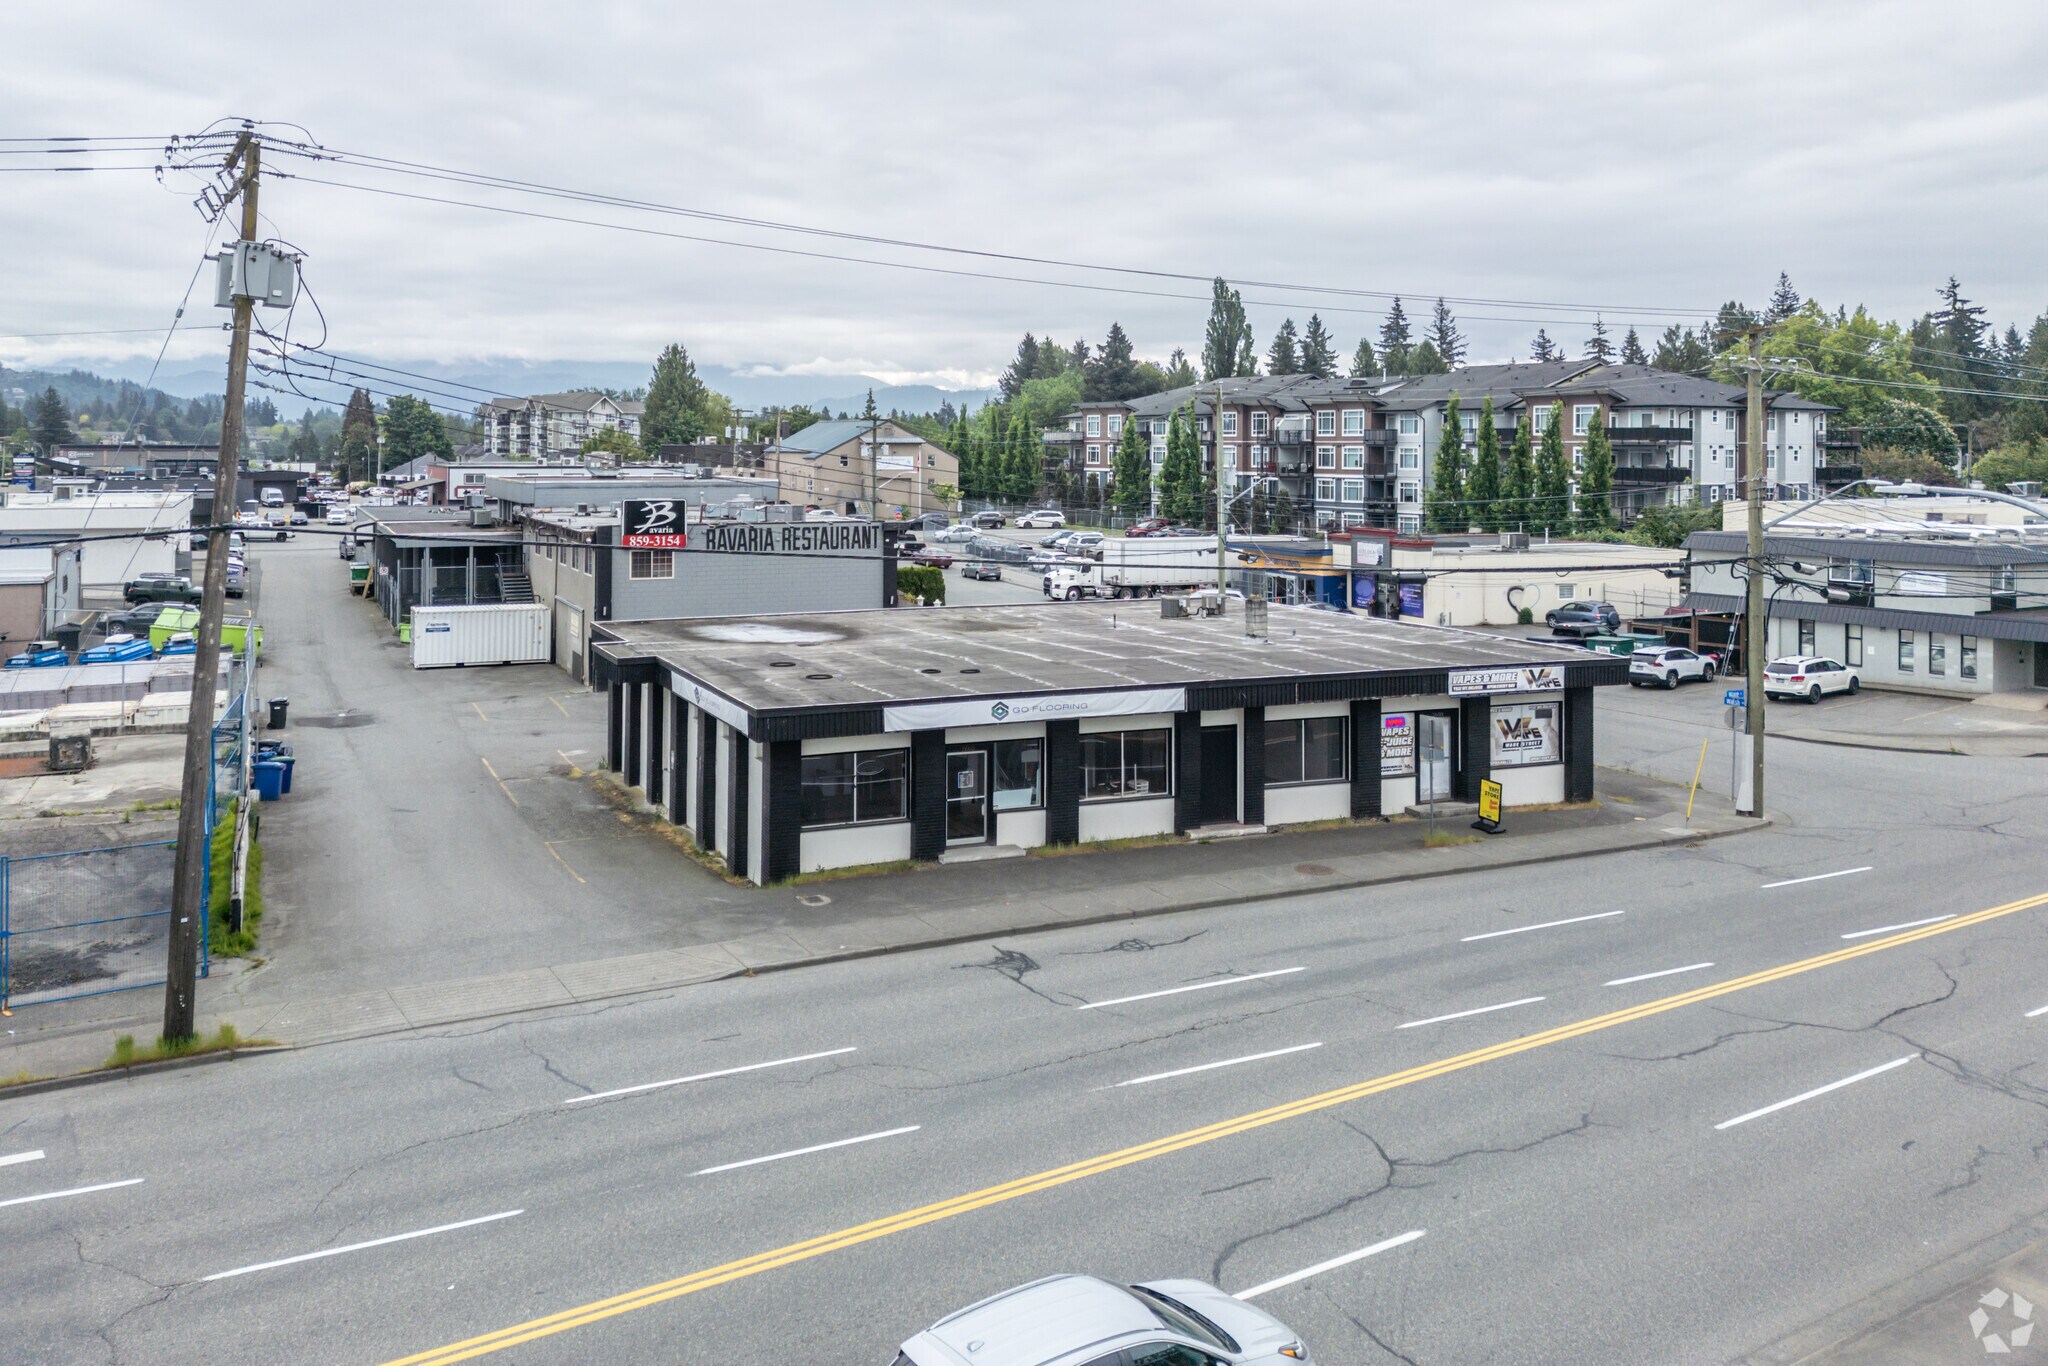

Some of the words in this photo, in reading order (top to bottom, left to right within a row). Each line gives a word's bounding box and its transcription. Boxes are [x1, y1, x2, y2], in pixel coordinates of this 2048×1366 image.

[629, 535, 680, 547] 859-3154
[782, 526, 880, 551] RESTAURANT
[1452, 675, 1483, 685] VAPES
[1490, 672, 1518, 682] MORE
[1012, 706, 1030, 714] GO
[1032, 703, 1088, 712] FLOORING
[1381, 727, 1409, 737] VAPES
[1386, 747, 1413, 758] MORE
[1484, 790, 1500, 799] STORE
